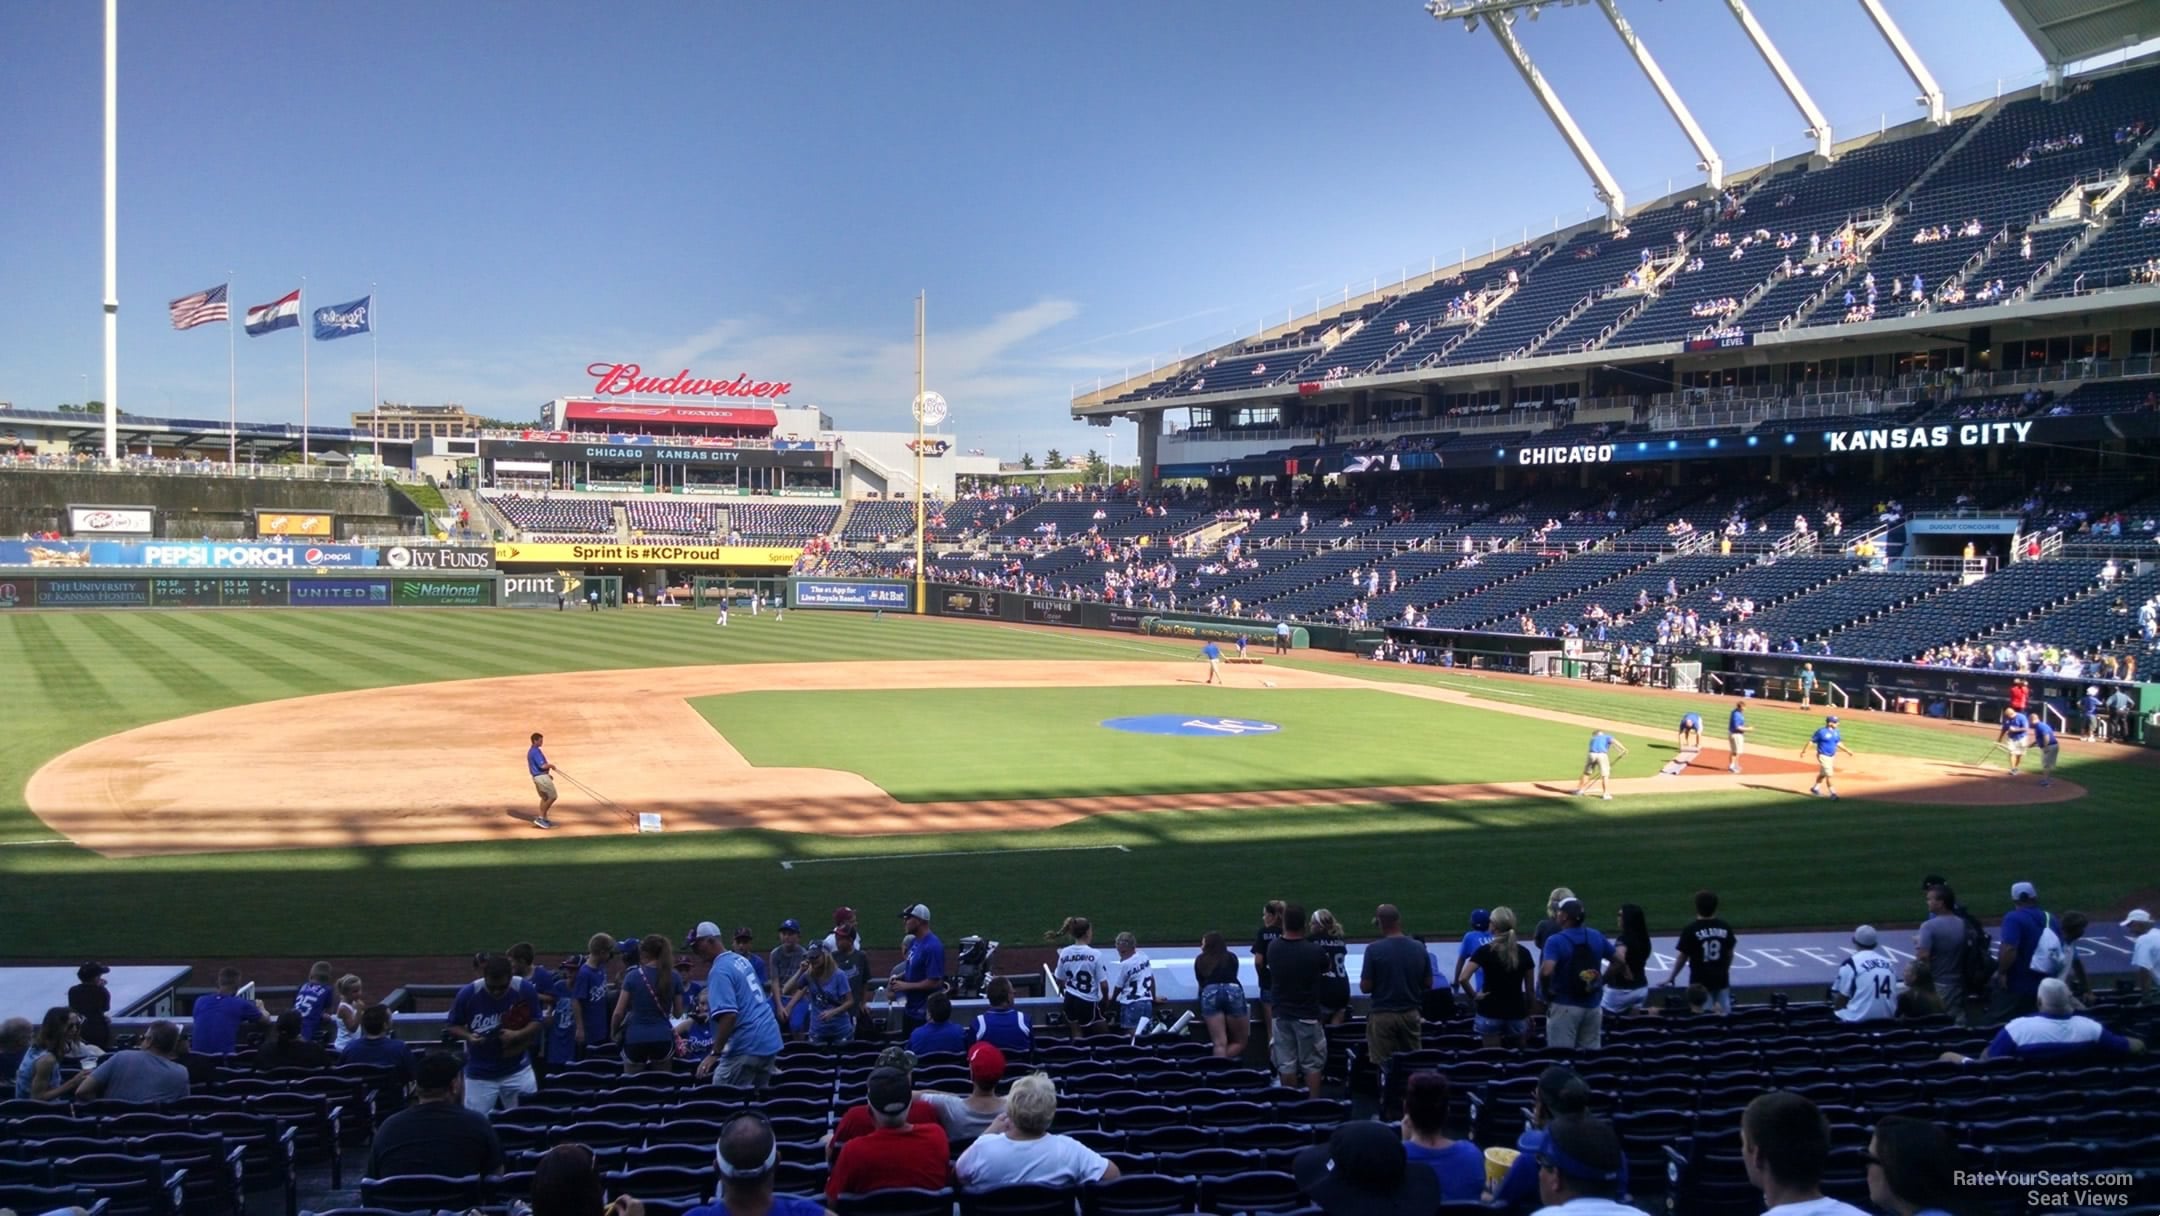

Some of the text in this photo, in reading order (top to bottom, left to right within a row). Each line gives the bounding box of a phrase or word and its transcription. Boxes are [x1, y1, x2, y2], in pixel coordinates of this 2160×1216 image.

[1721, 338, 1745, 348] LEVEL
[587, 363, 792, 399] Budweiser
[1830, 421, 2033, 451] KANSAS CITY
[586, 448, 739, 461] CHICAGO KANSAS CITY
[1519, 445, 1613, 465] CHICAGO
[593, 484, 645, 493] Commerce Bank
[689, 487, 740, 496] Commerce Bank
[785, 489, 818, 497] Commerce
[145, 546, 294, 565] PEPSI PORCH
[323, 552, 352, 563] pepsi
[573, 545, 720, 561] Sprint is #KCProud
[768, 552, 794, 562] Sprint
[48, 581, 137, 592] THE UNIVERSITY
[419, 583, 480, 597] National
[810, 586, 824, 594] The
[832, 587, 846, 595] App
[39, 592, 145, 601] OF KANSAS HOSPITAL
[296, 587, 366, 599] UNITED
[801, 594, 865, 603] Live Royals Baseball
[878, 590, 905, 602] At Bat
[1156, 623, 1173, 634] JOHN
[1173, 624, 1196, 637] DEERE
[1701, 939, 1722, 963] 18
[1873, 974, 1892, 999] 14
